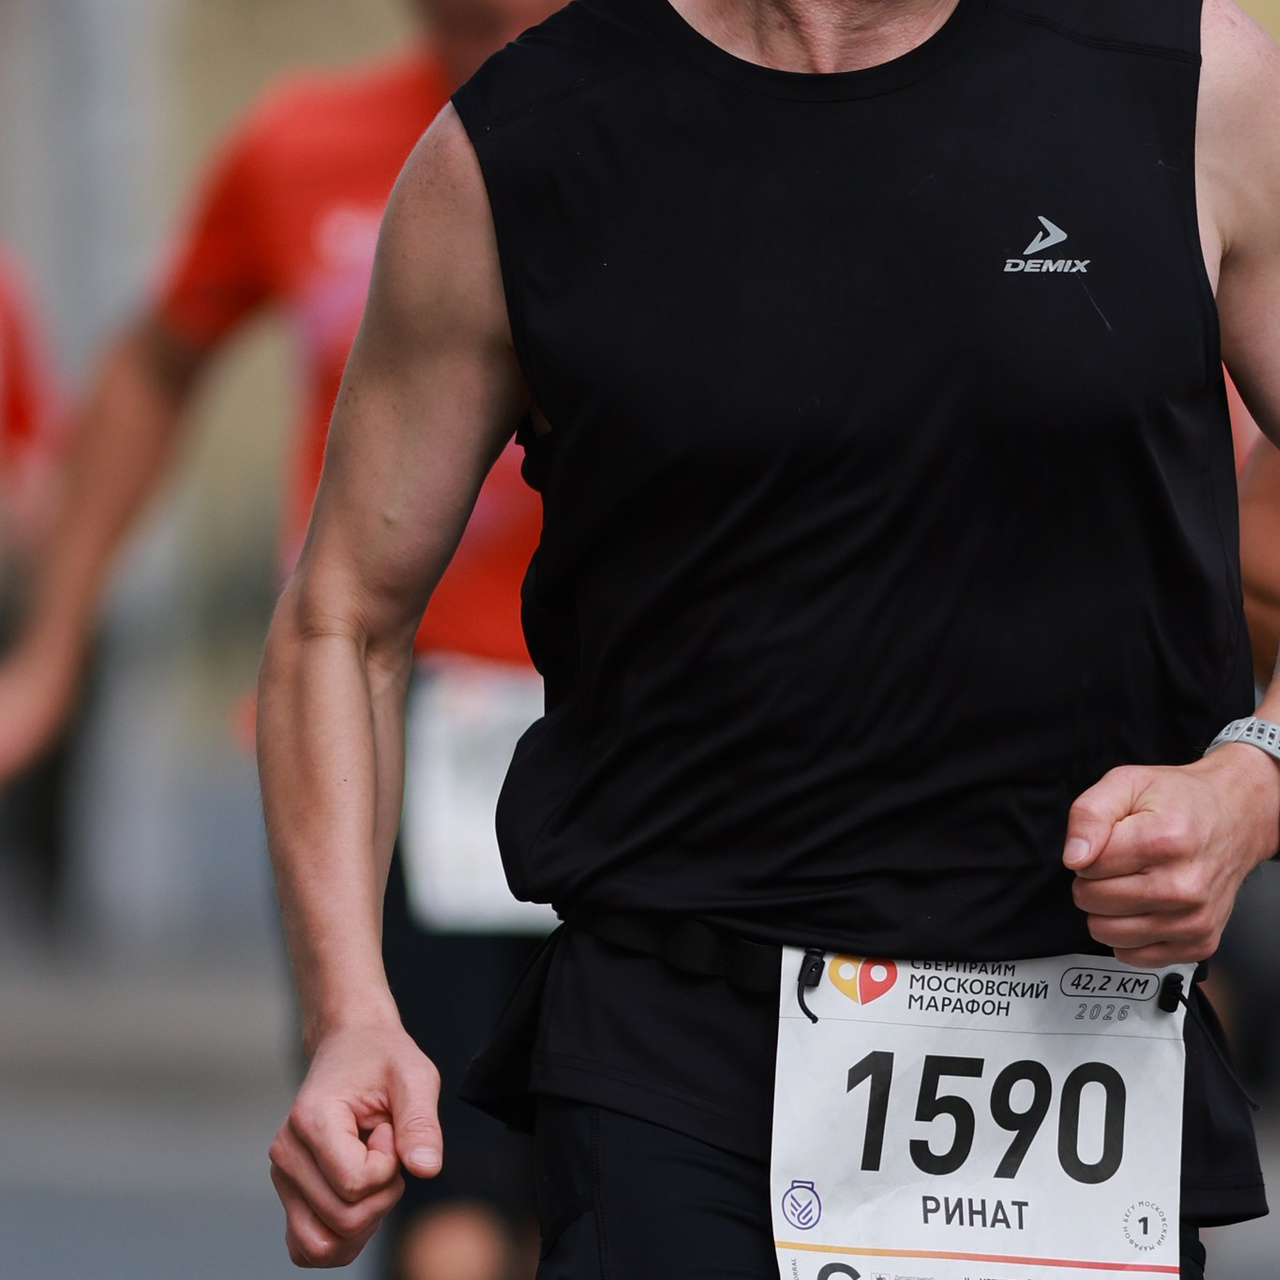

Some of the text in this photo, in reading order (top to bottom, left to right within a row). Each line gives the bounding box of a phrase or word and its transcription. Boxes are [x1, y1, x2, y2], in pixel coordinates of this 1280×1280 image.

[1003, 259, 1091, 273] DEMIX
[909, 973, 1049, 1000] МОСКОВСКИЙ
[1070, 973, 1109, 992] 42,2
[908, 994, 1011, 1017] МАРАФОН
[1074, 1003, 1130, 1021] 2026
[846, 1050, 1127, 1185] 1590
[921, 1195, 1029, 1231] РИНАТ
[1138, 1216, 1149, 1235] 1
